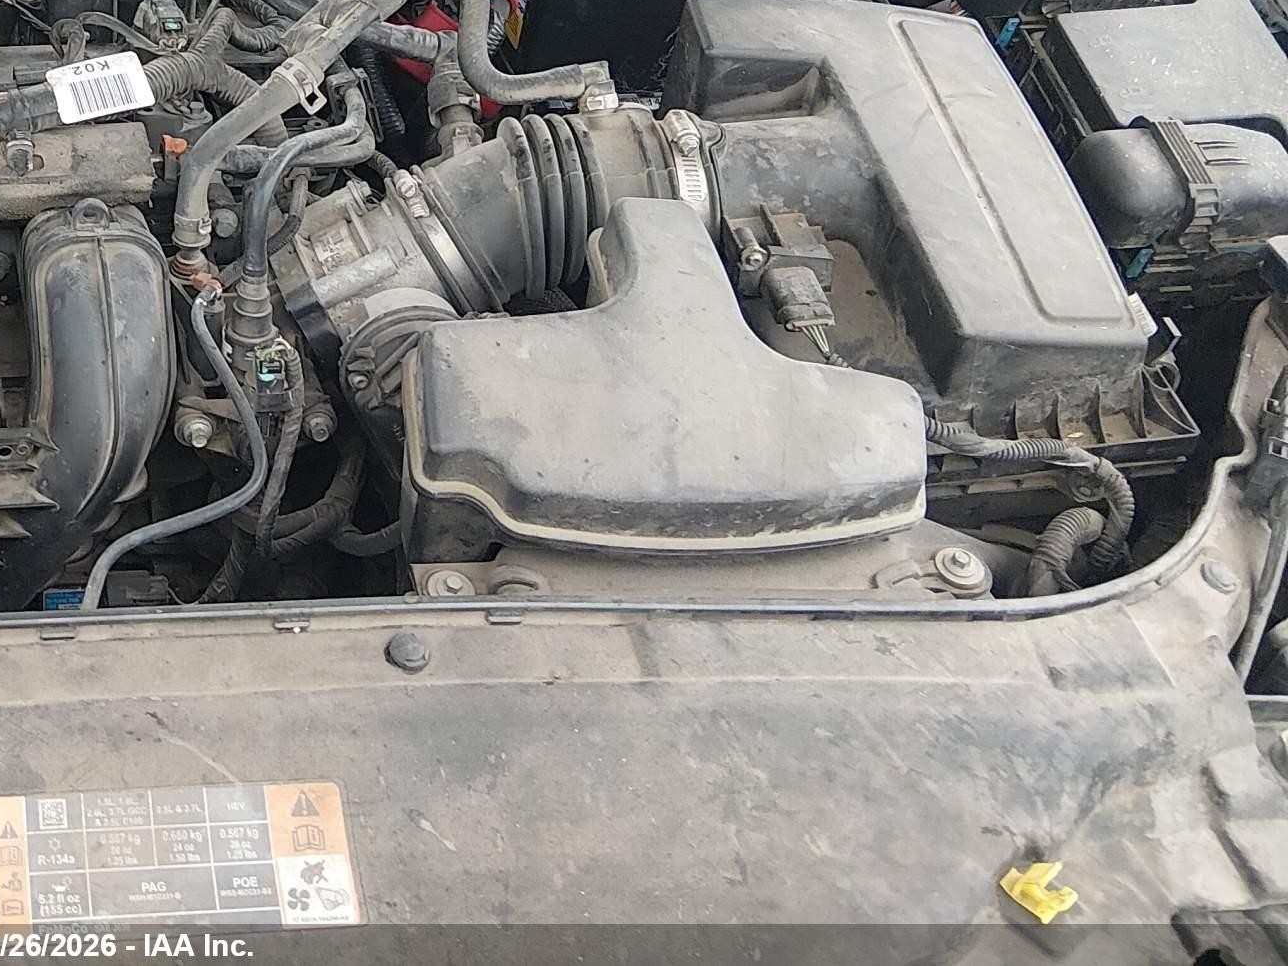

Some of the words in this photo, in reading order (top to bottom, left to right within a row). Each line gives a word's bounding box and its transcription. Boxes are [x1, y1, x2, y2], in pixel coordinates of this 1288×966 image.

[189, 829, 203, 842] kg
[245, 826, 259, 839] kg
[38, 854, 75, 865] R-134a
[141, 881, 167, 893] PAG
[232, 876, 258, 888] POE
[38, 894, 55, 904] 5.2
[67, 895, 81, 903] oz
[40, 904, 64, 917] (155
[65, 903, 83, 915] cc)
